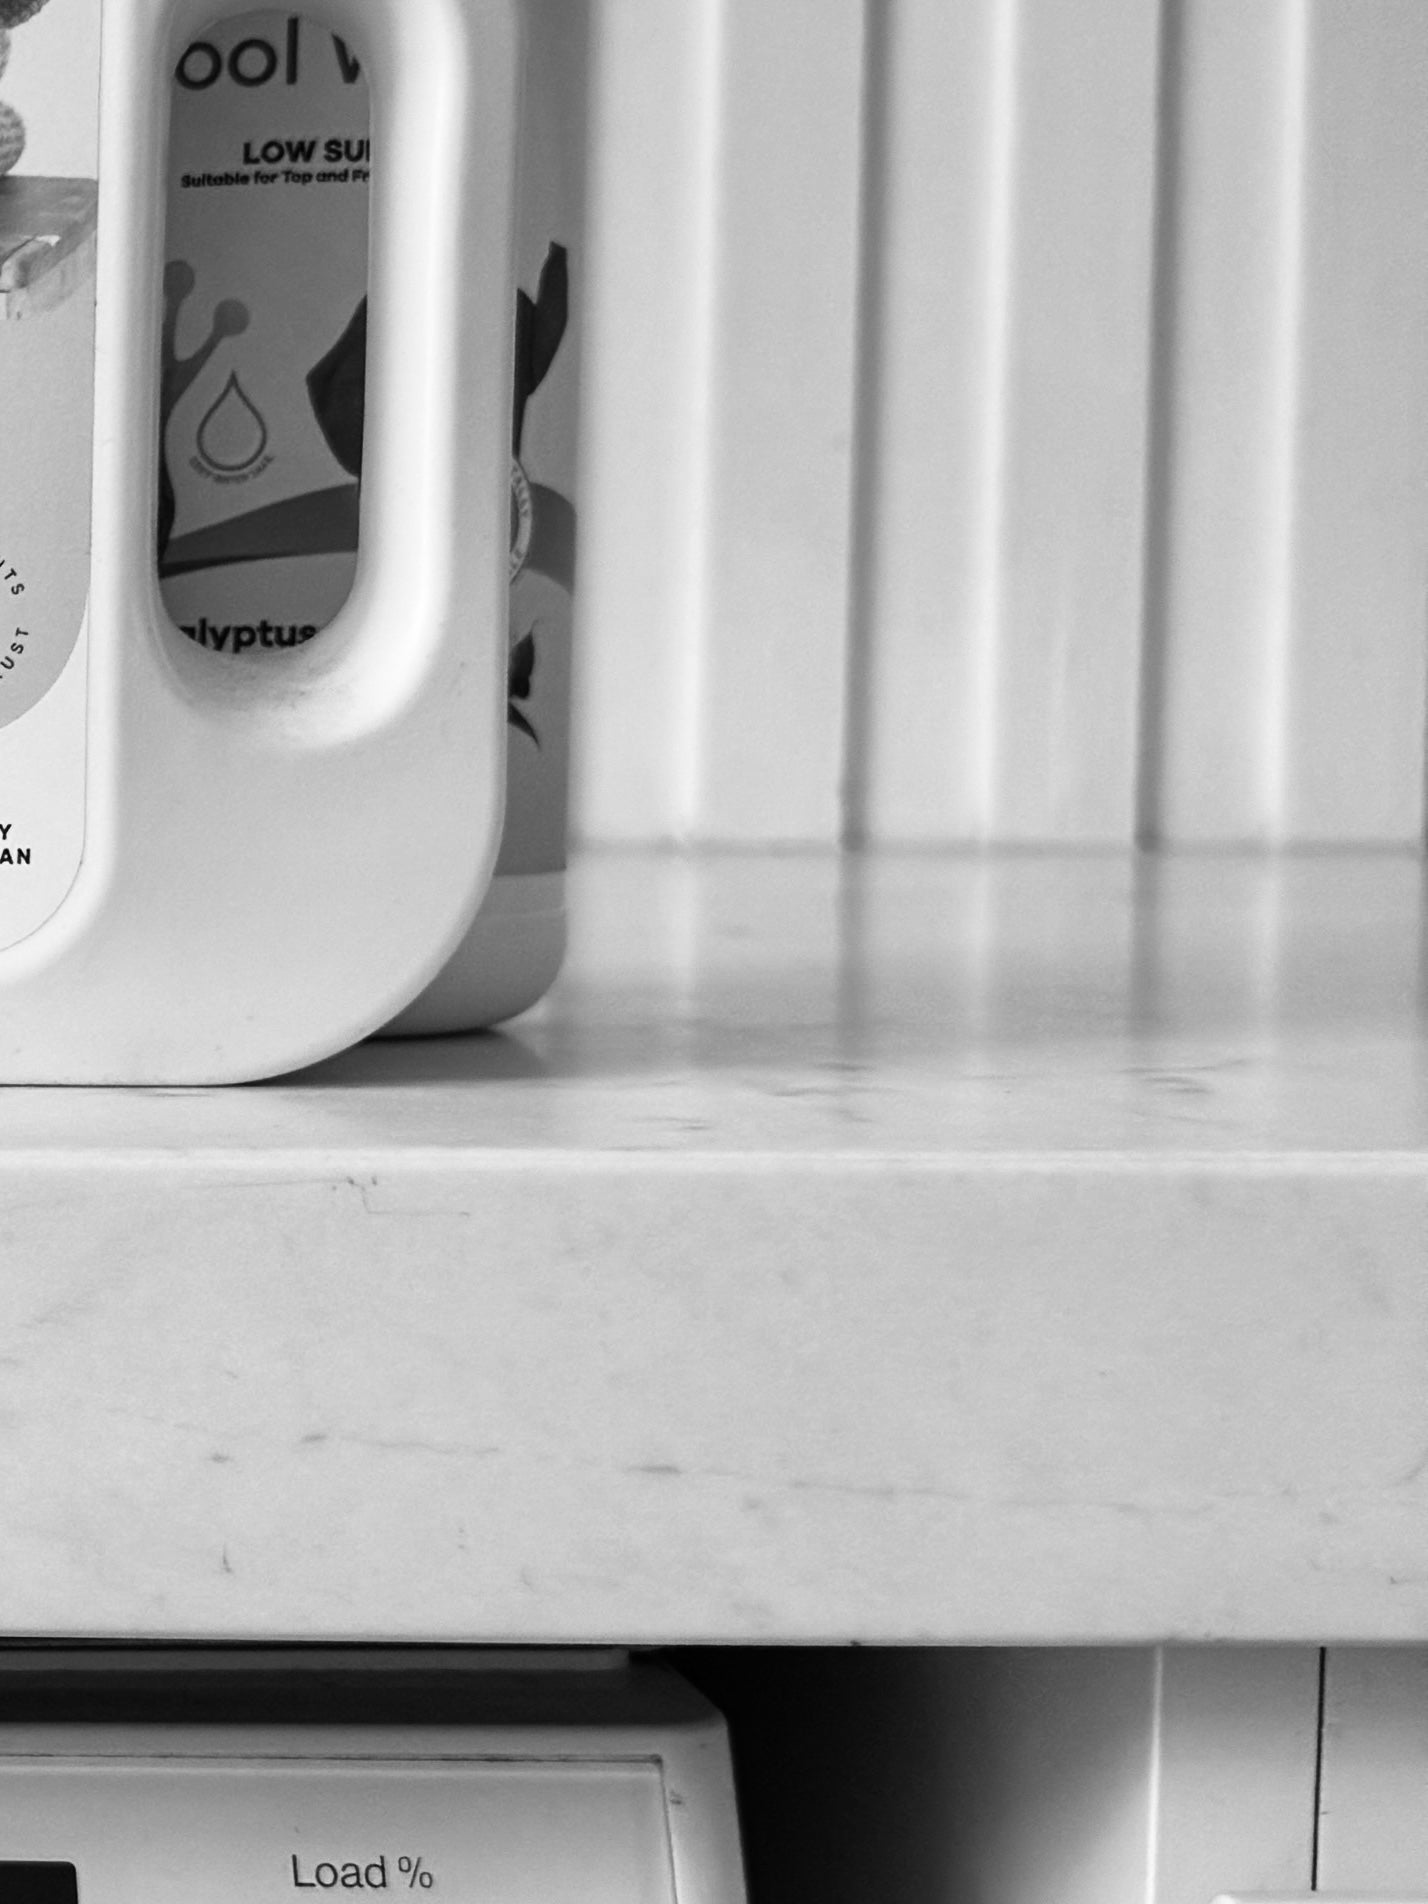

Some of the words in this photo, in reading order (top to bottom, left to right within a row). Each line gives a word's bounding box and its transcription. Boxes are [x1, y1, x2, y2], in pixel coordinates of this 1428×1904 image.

[243, 140, 317, 165] LOW
[181, 172, 250, 189] Suitable
[253, 170, 279, 185] for
[281, 169, 314, 185] Top
[315, 168, 350, 183] and
[291, 1854, 388, 1889] Load
[397, 1855, 434, 1889] %
